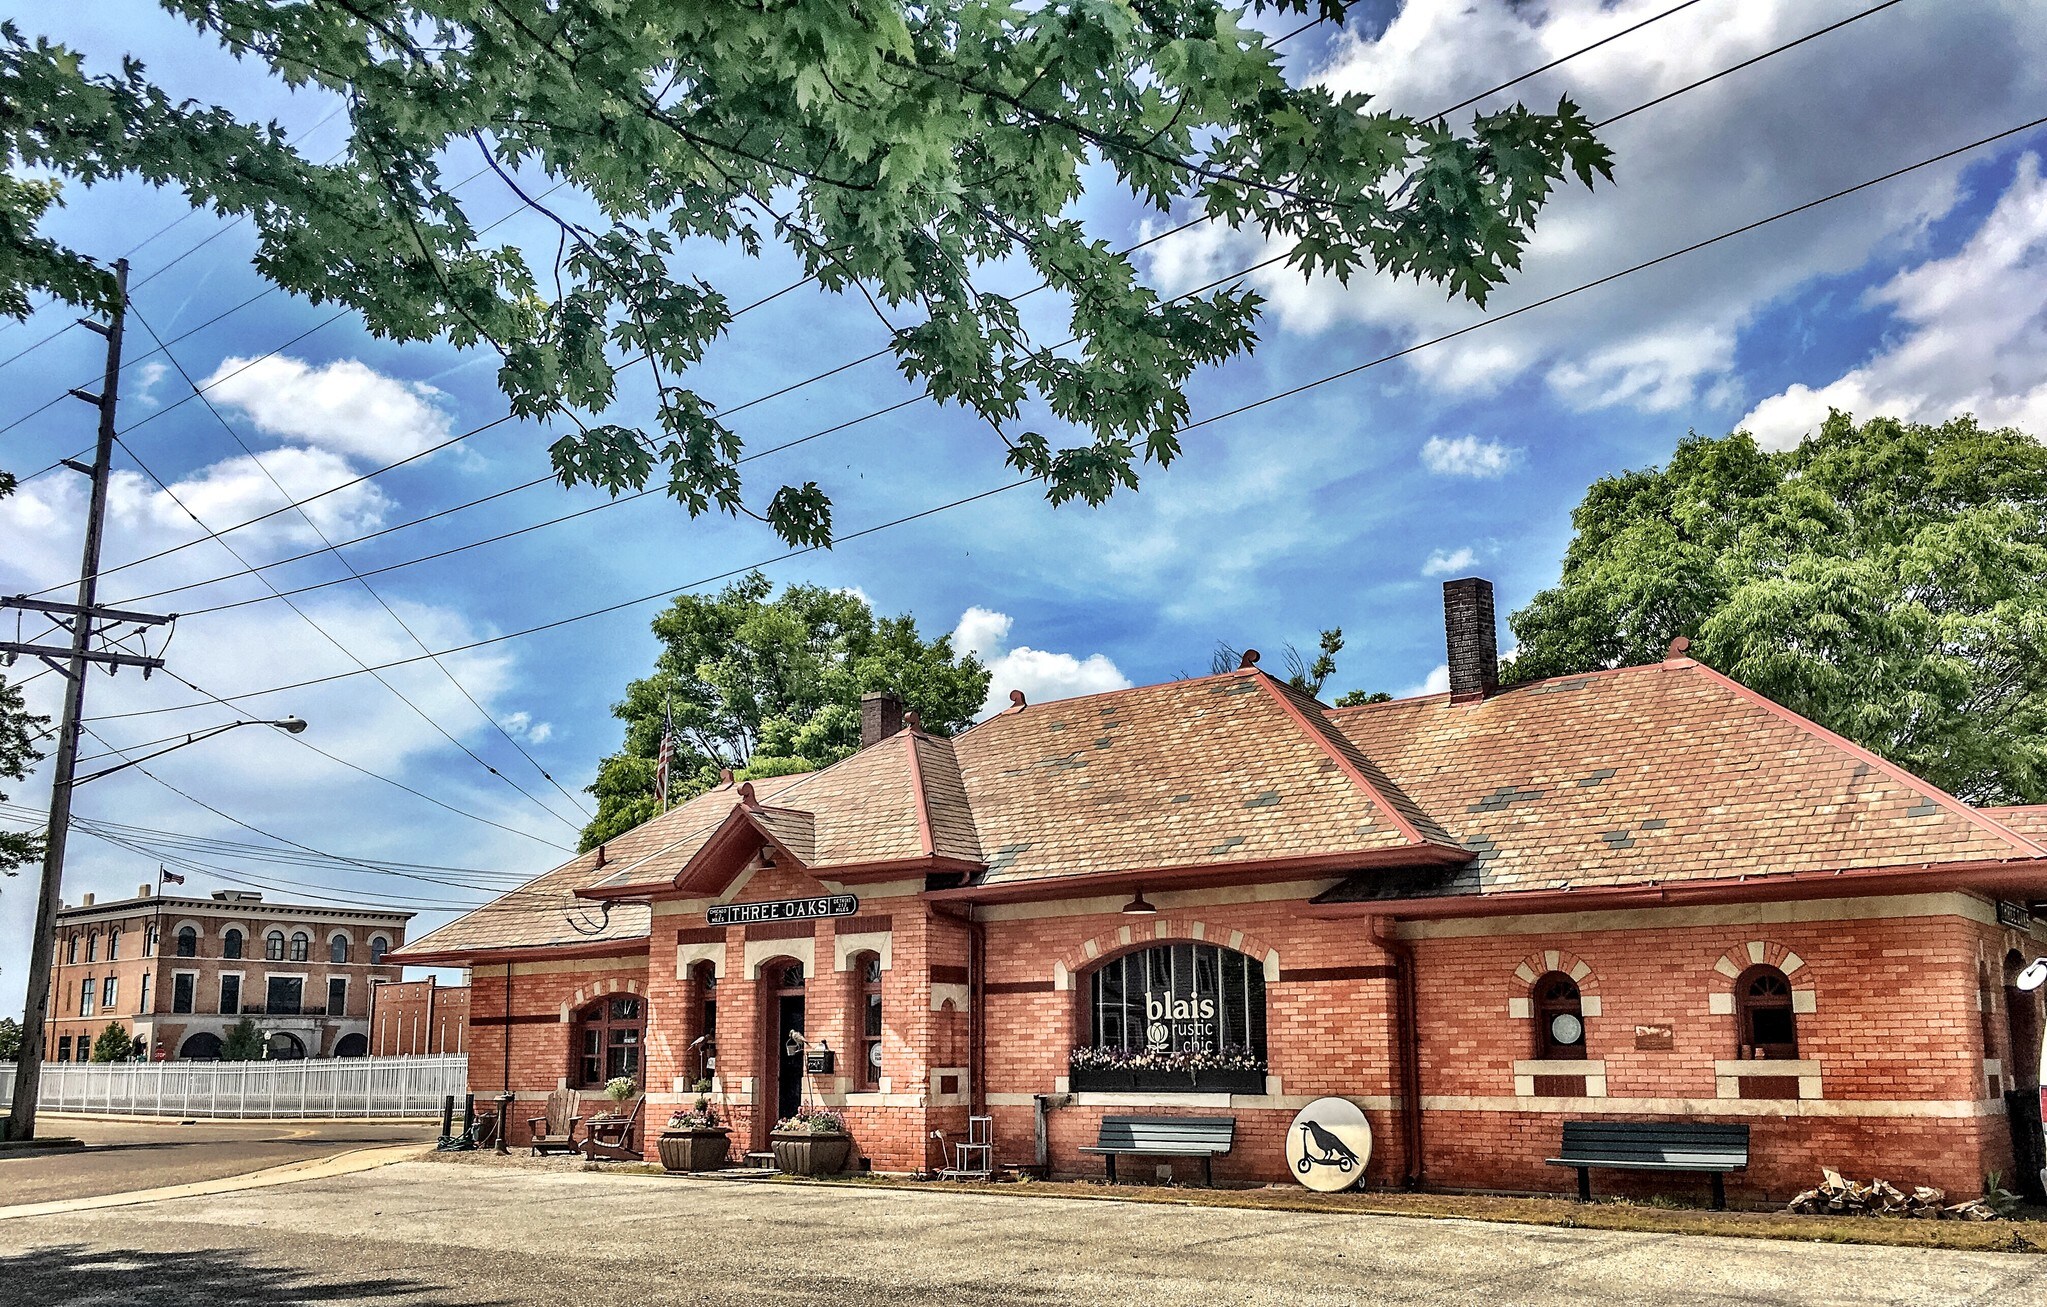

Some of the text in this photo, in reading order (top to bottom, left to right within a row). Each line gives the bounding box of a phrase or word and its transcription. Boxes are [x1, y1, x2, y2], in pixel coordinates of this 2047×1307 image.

[731, 900, 827, 921] THREE OAKS
[1144, 991, 1215, 1021] blais
[1171, 1020, 1213, 1037] rustic
[1183, 1037, 1213, 1053] chic
